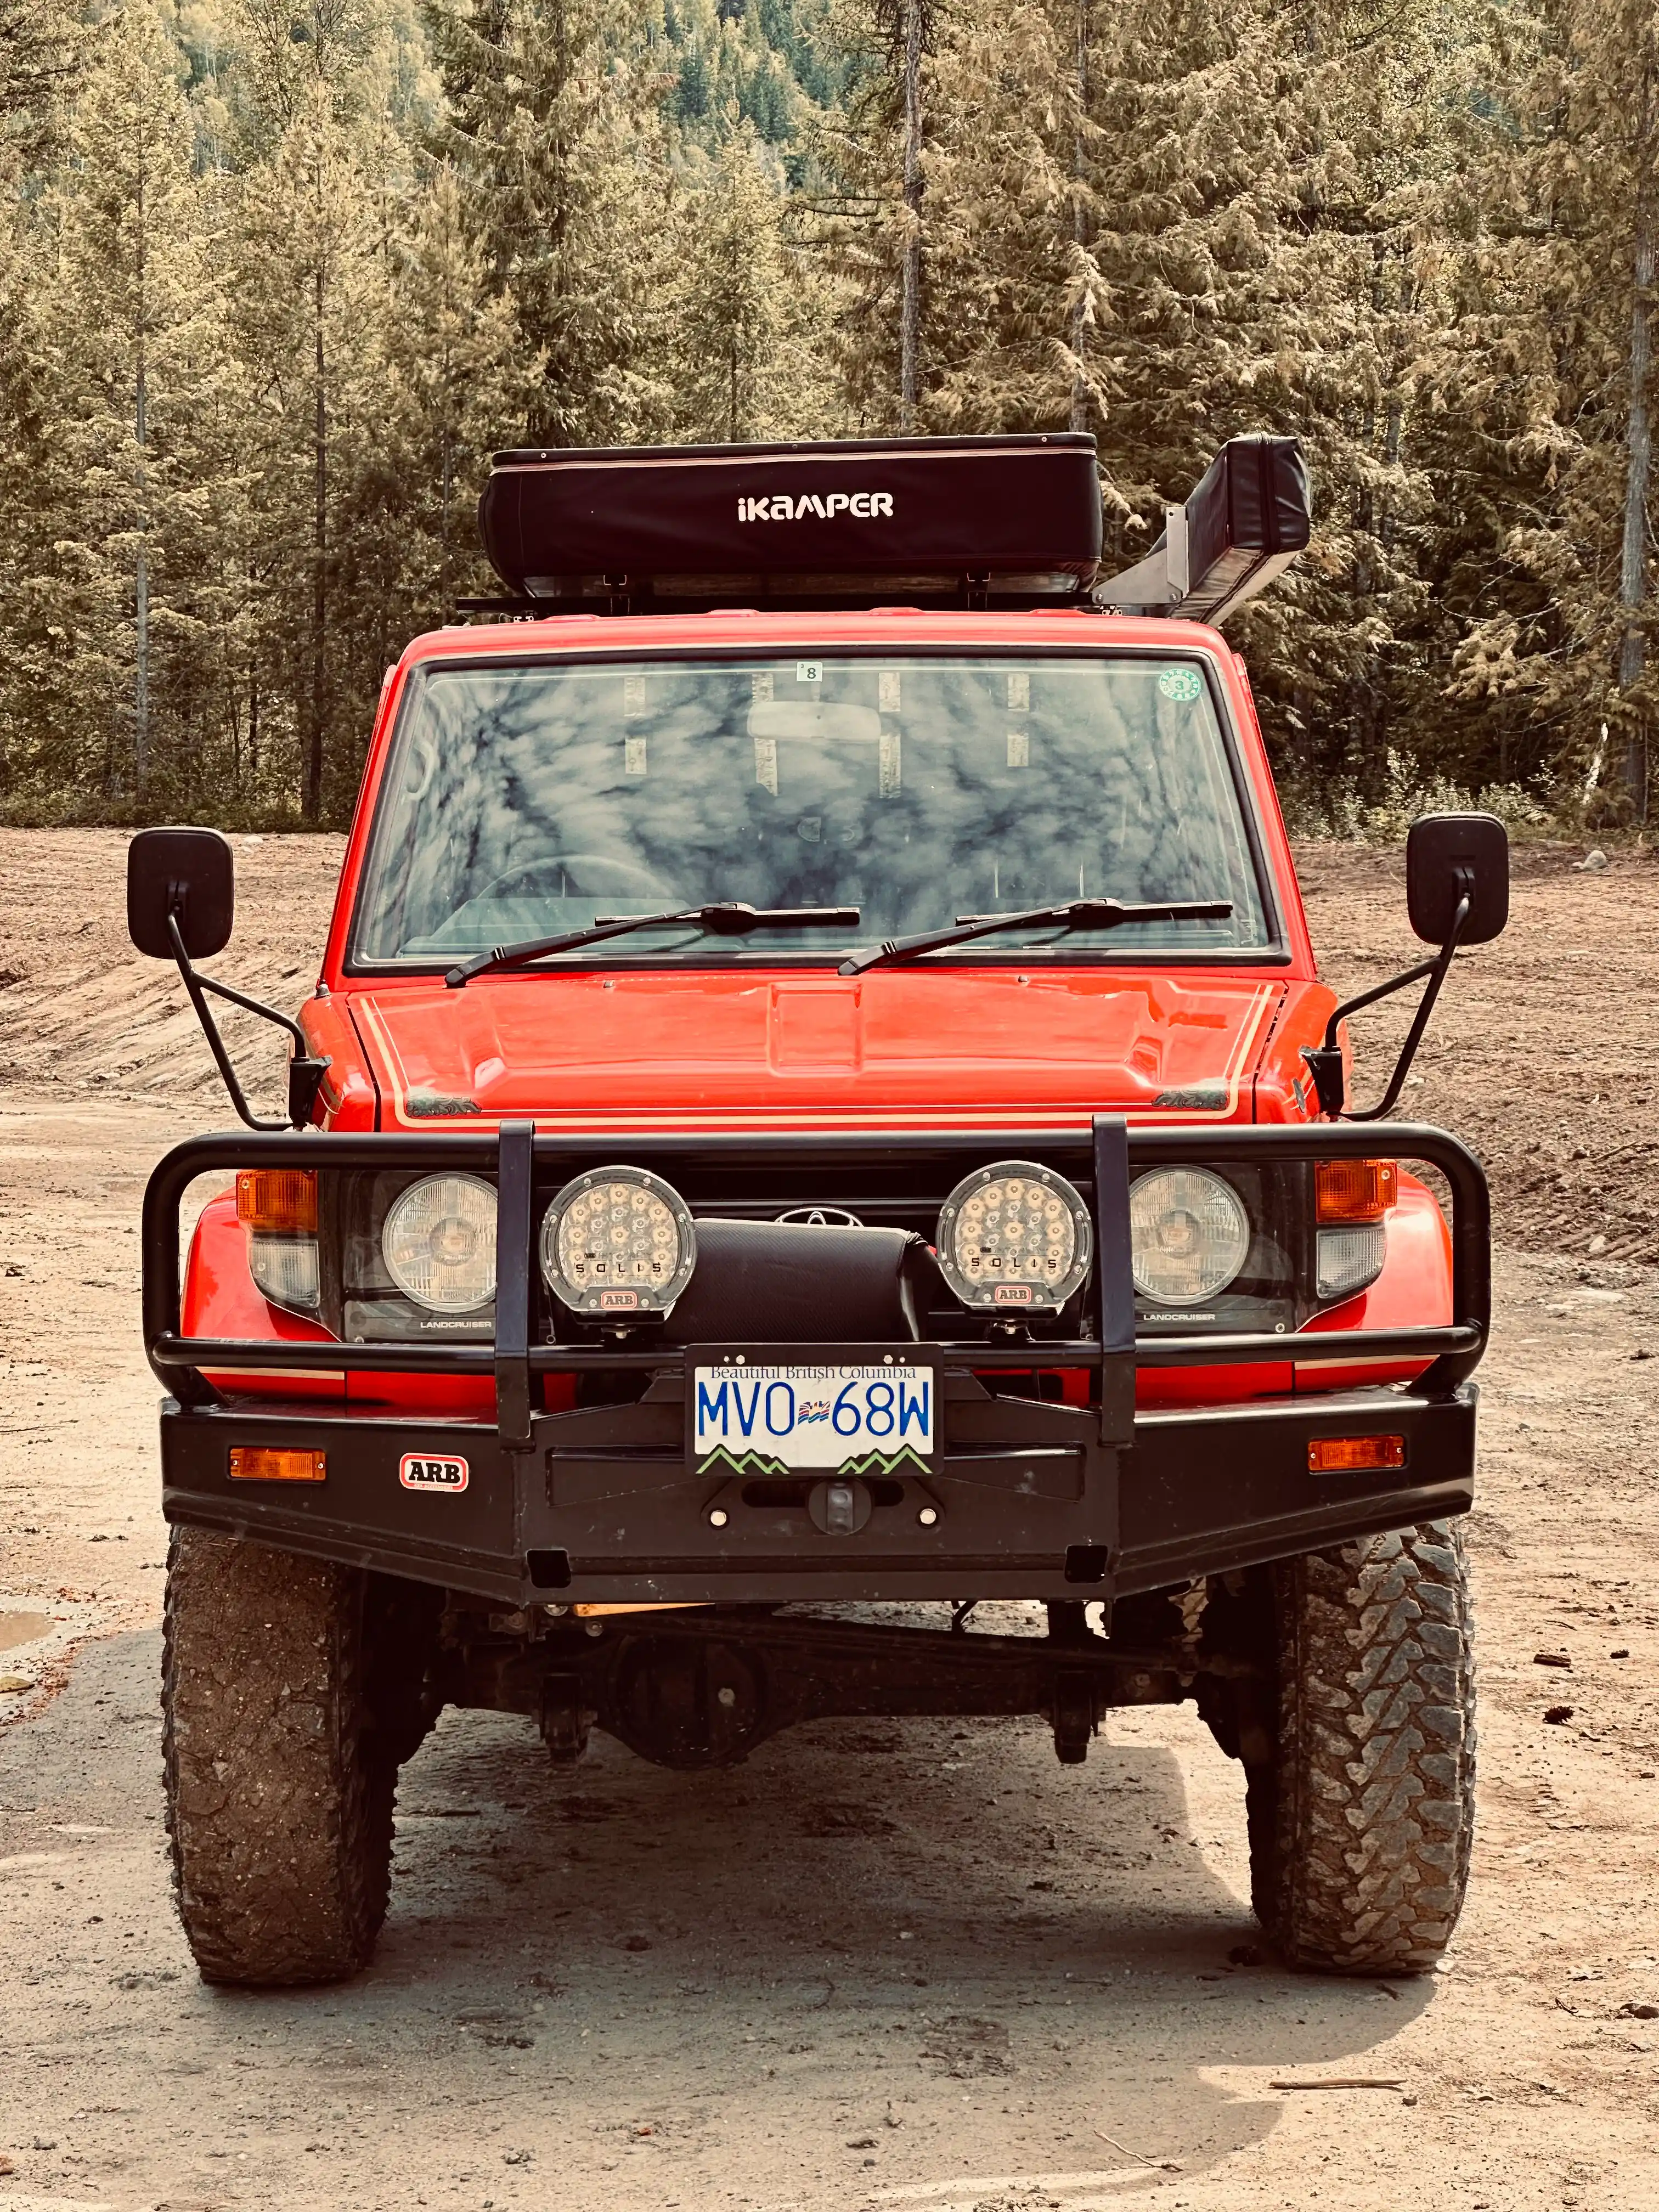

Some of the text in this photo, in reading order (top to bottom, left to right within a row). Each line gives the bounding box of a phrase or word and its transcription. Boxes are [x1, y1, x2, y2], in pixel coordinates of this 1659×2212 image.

[807, 668, 816, 679] 8
[1175, 680, 1184, 690] 3
[575, 1263, 661, 1273] SOLIS
[970, 1257, 1057, 1268] SOLIS
[605, 1295, 634, 1306] ARB
[1000, 1290, 1028, 1300] ARB
[712, 1367, 917, 1379] Beautiful British Columbia
[832, 1381, 929, 1436] 68W
[408, 1462, 460, 1483] ARB
